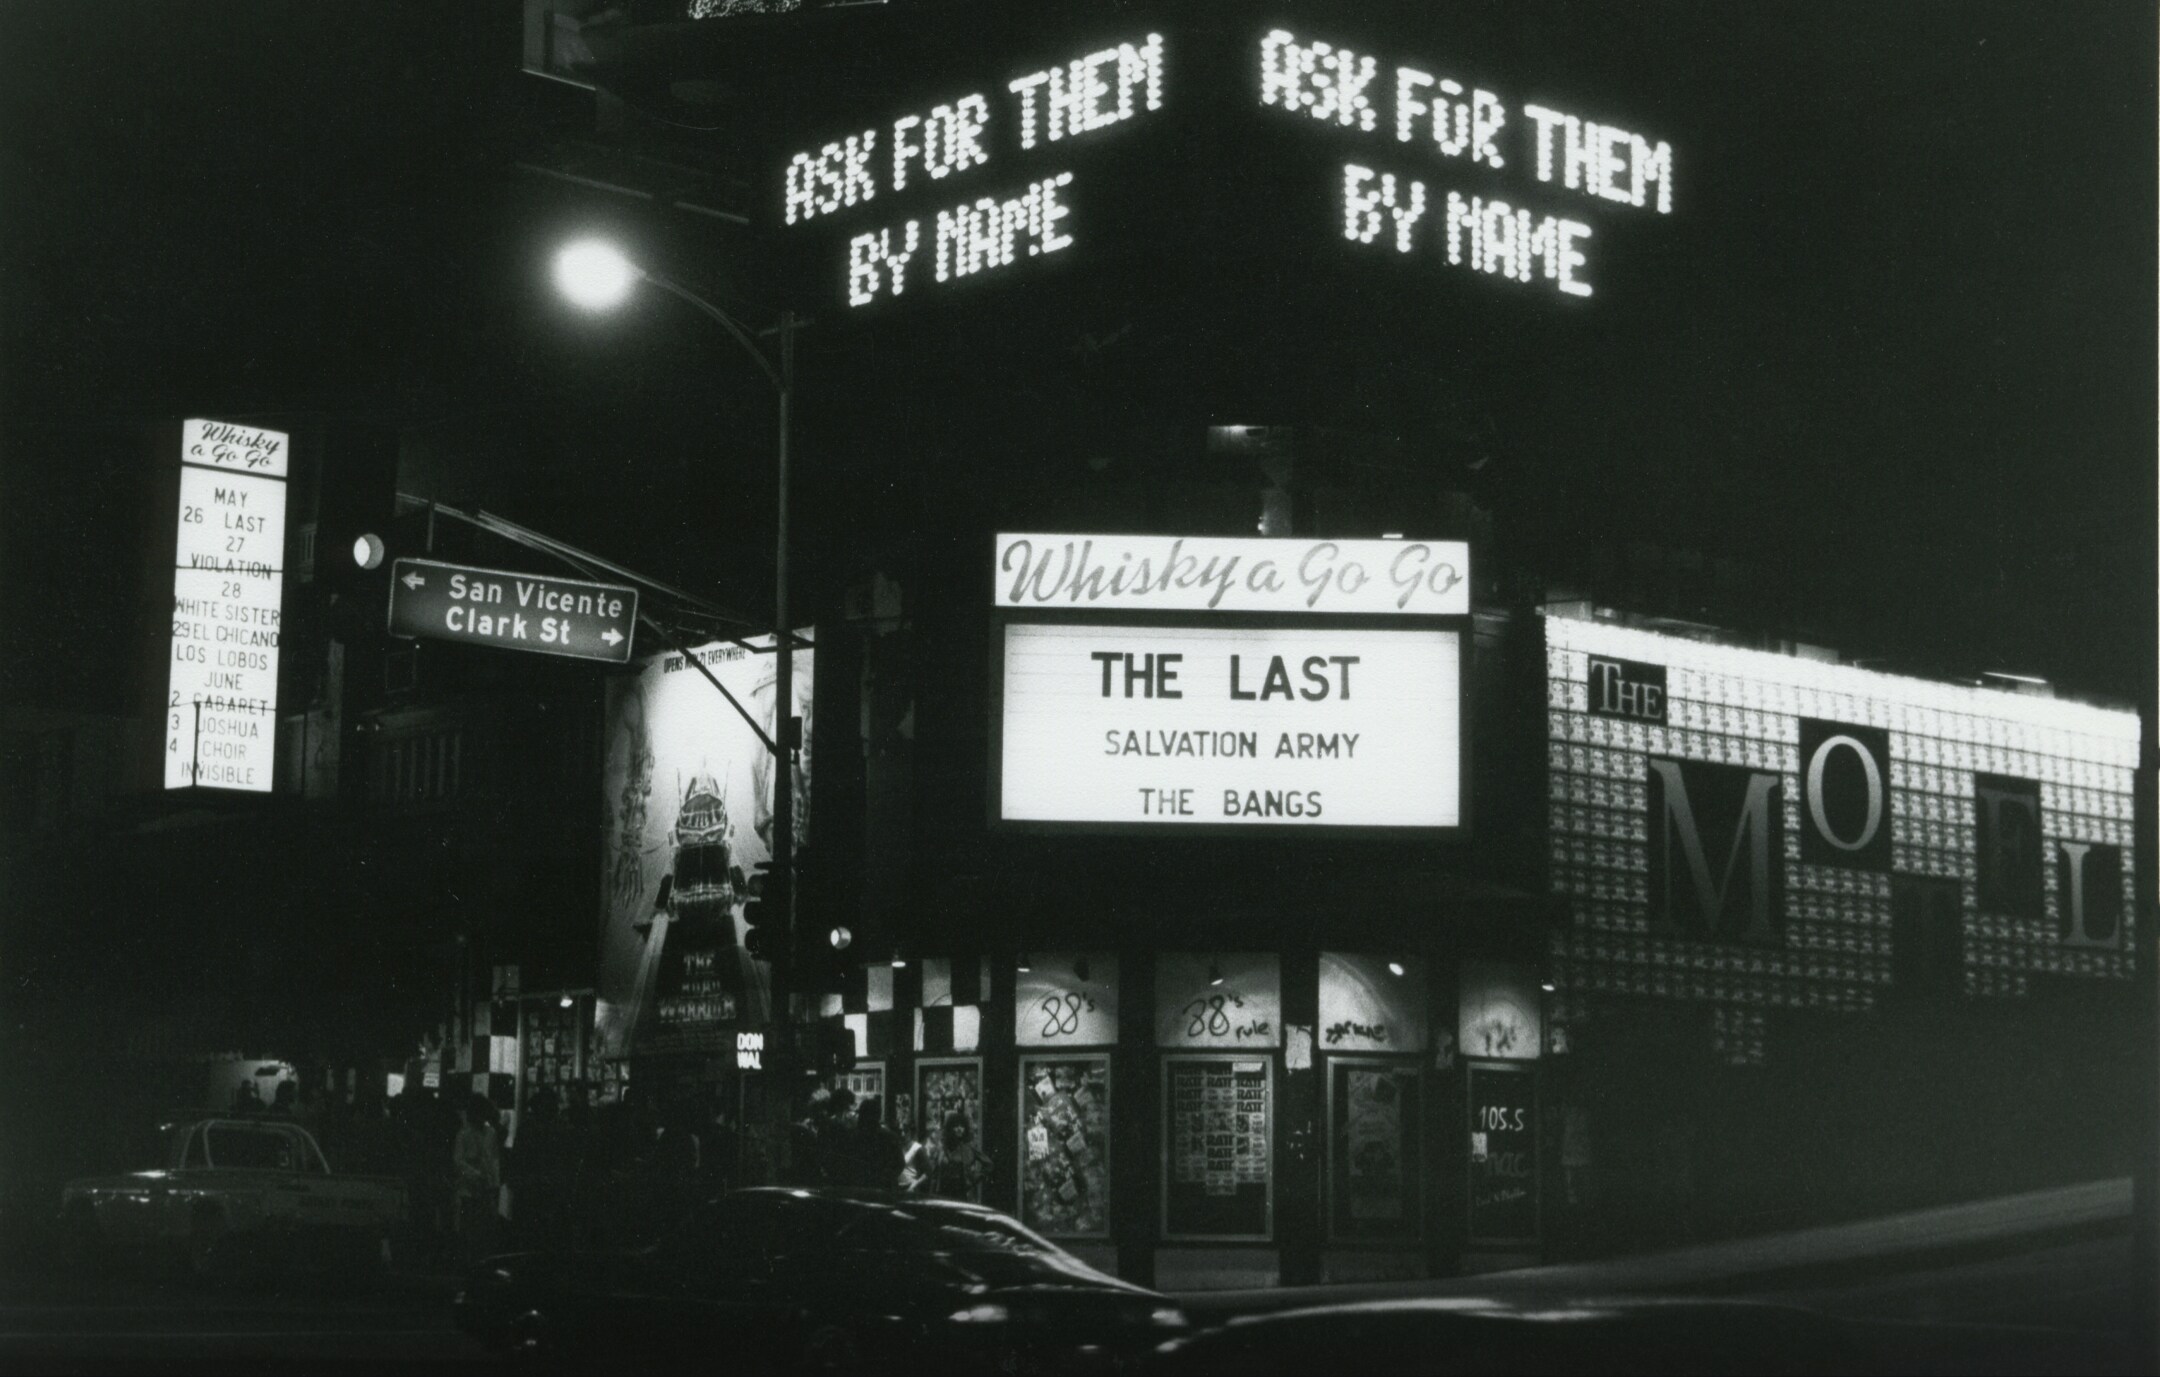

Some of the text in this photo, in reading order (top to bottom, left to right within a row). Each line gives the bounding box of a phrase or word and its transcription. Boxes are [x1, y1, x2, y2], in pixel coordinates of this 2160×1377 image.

[785, 32, 1163, 225] ASK FOR THEM
[1260, 29, 1671, 215] ASK FOR THEM
[849, 171, 1073, 307] BY NAME
[1344, 164, 1593, 298] BY NAME
[202, 423, 280, 455] Whisky
[191, 444, 272, 468] a Go Go
[214, 487, 248, 507] MAY
[184, 506, 265, 533] 26 LAST
[226, 536, 245, 552] 27
[191, 553, 272, 580] VIOLATION
[1001, 539, 1463, 609] Whisky a Go Go
[221, 581, 241, 598] 28
[449, 574, 623, 618] San Vicente
[175, 598, 280, 626] WHITE SISTER
[445, 606, 570, 645] Clark St
[173, 620, 279, 648] 29 EL CHICANO
[176, 644, 268, 671] LOS LOBOS
[663, 656, 683, 673] OPENS
[708, 646, 746, 665] EVERYWHERE
[204, 672, 244, 690] JUNE
[1091, 651, 1360, 702] THE LAST
[1590, 659, 1663, 720] THE
[172, 691, 269, 717] 2 CABARET
[172, 714, 259, 738] 3 JOSHUA
[169, 737, 247, 760] 4 CHOIR
[1104, 730, 1360, 759] SALVATION ARMY
[181, 762, 255, 785] INVISIBLE
[1139, 788, 1322, 818] THE BANGS
[1235, 1020, 1270, 1041] rule
